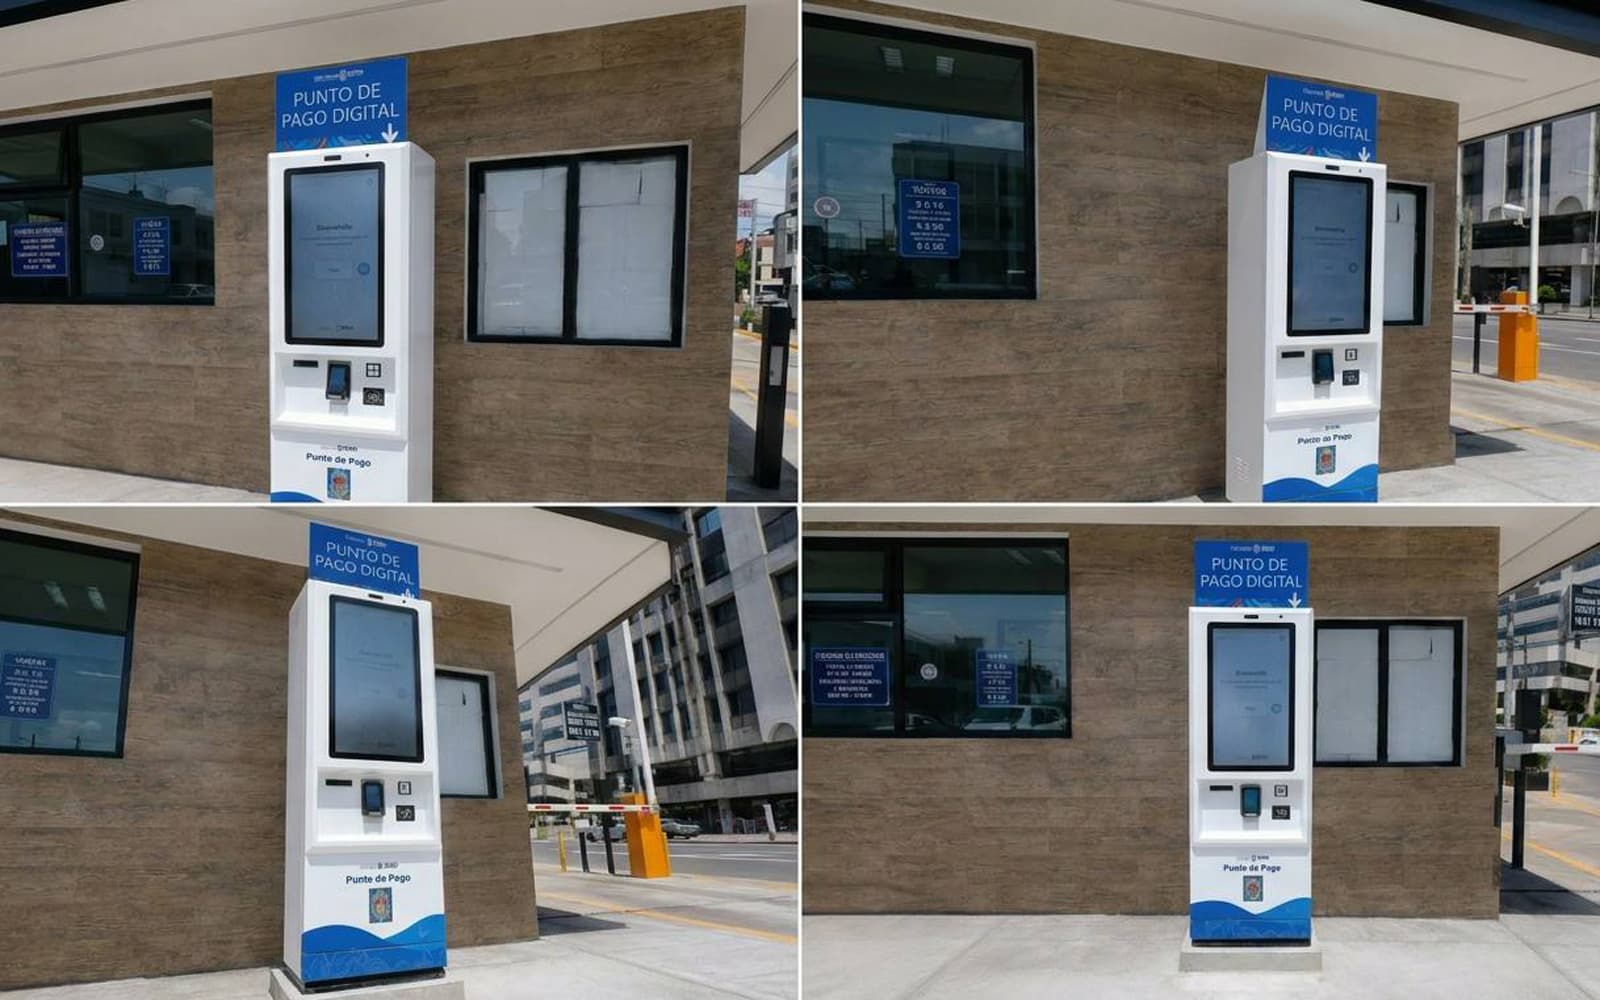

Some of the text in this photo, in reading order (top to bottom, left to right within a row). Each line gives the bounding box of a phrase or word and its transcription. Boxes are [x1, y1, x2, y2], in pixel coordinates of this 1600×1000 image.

[294, 82, 381, 107] PUNTO DE
[282, 102, 400, 128] PAGO DIGITAL
[1284, 98, 1358, 122] PUNTO DE
[1272, 115, 1372, 142] PAGO DIGITAL
[335, 456, 347, 464] de
[326, 542, 401, 568] PUNTO DE
[1212, 557, 1288, 571] PUNTO DE
[361, 564, 415, 586] DIGITAL
[1200, 574, 1303, 588] PAGO DIGITAL
[375, 874, 387, 883] de
